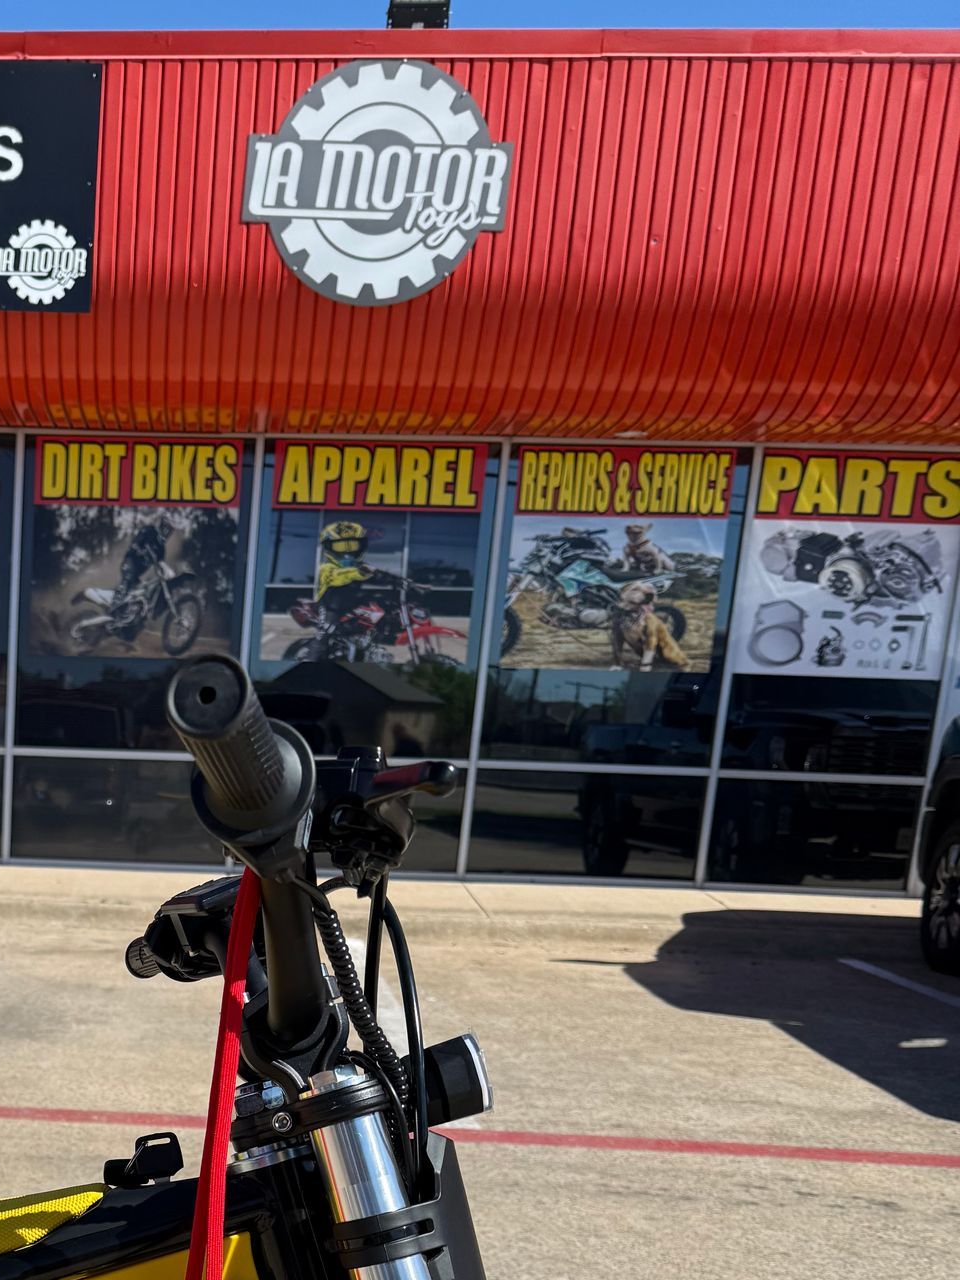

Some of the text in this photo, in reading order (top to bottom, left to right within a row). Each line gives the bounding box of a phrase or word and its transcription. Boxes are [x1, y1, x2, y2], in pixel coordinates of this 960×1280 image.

[249, 141, 507, 215] LA MOTOR
[19, 249, 87, 276] MOTOR
[41, 442, 238, 504] DIRT BIKES
[277, 444, 477, 507] APPAREL
[518, 450, 732, 516] REPAIRS & SERVICE
[757, 455, 960, 519] PARTS
